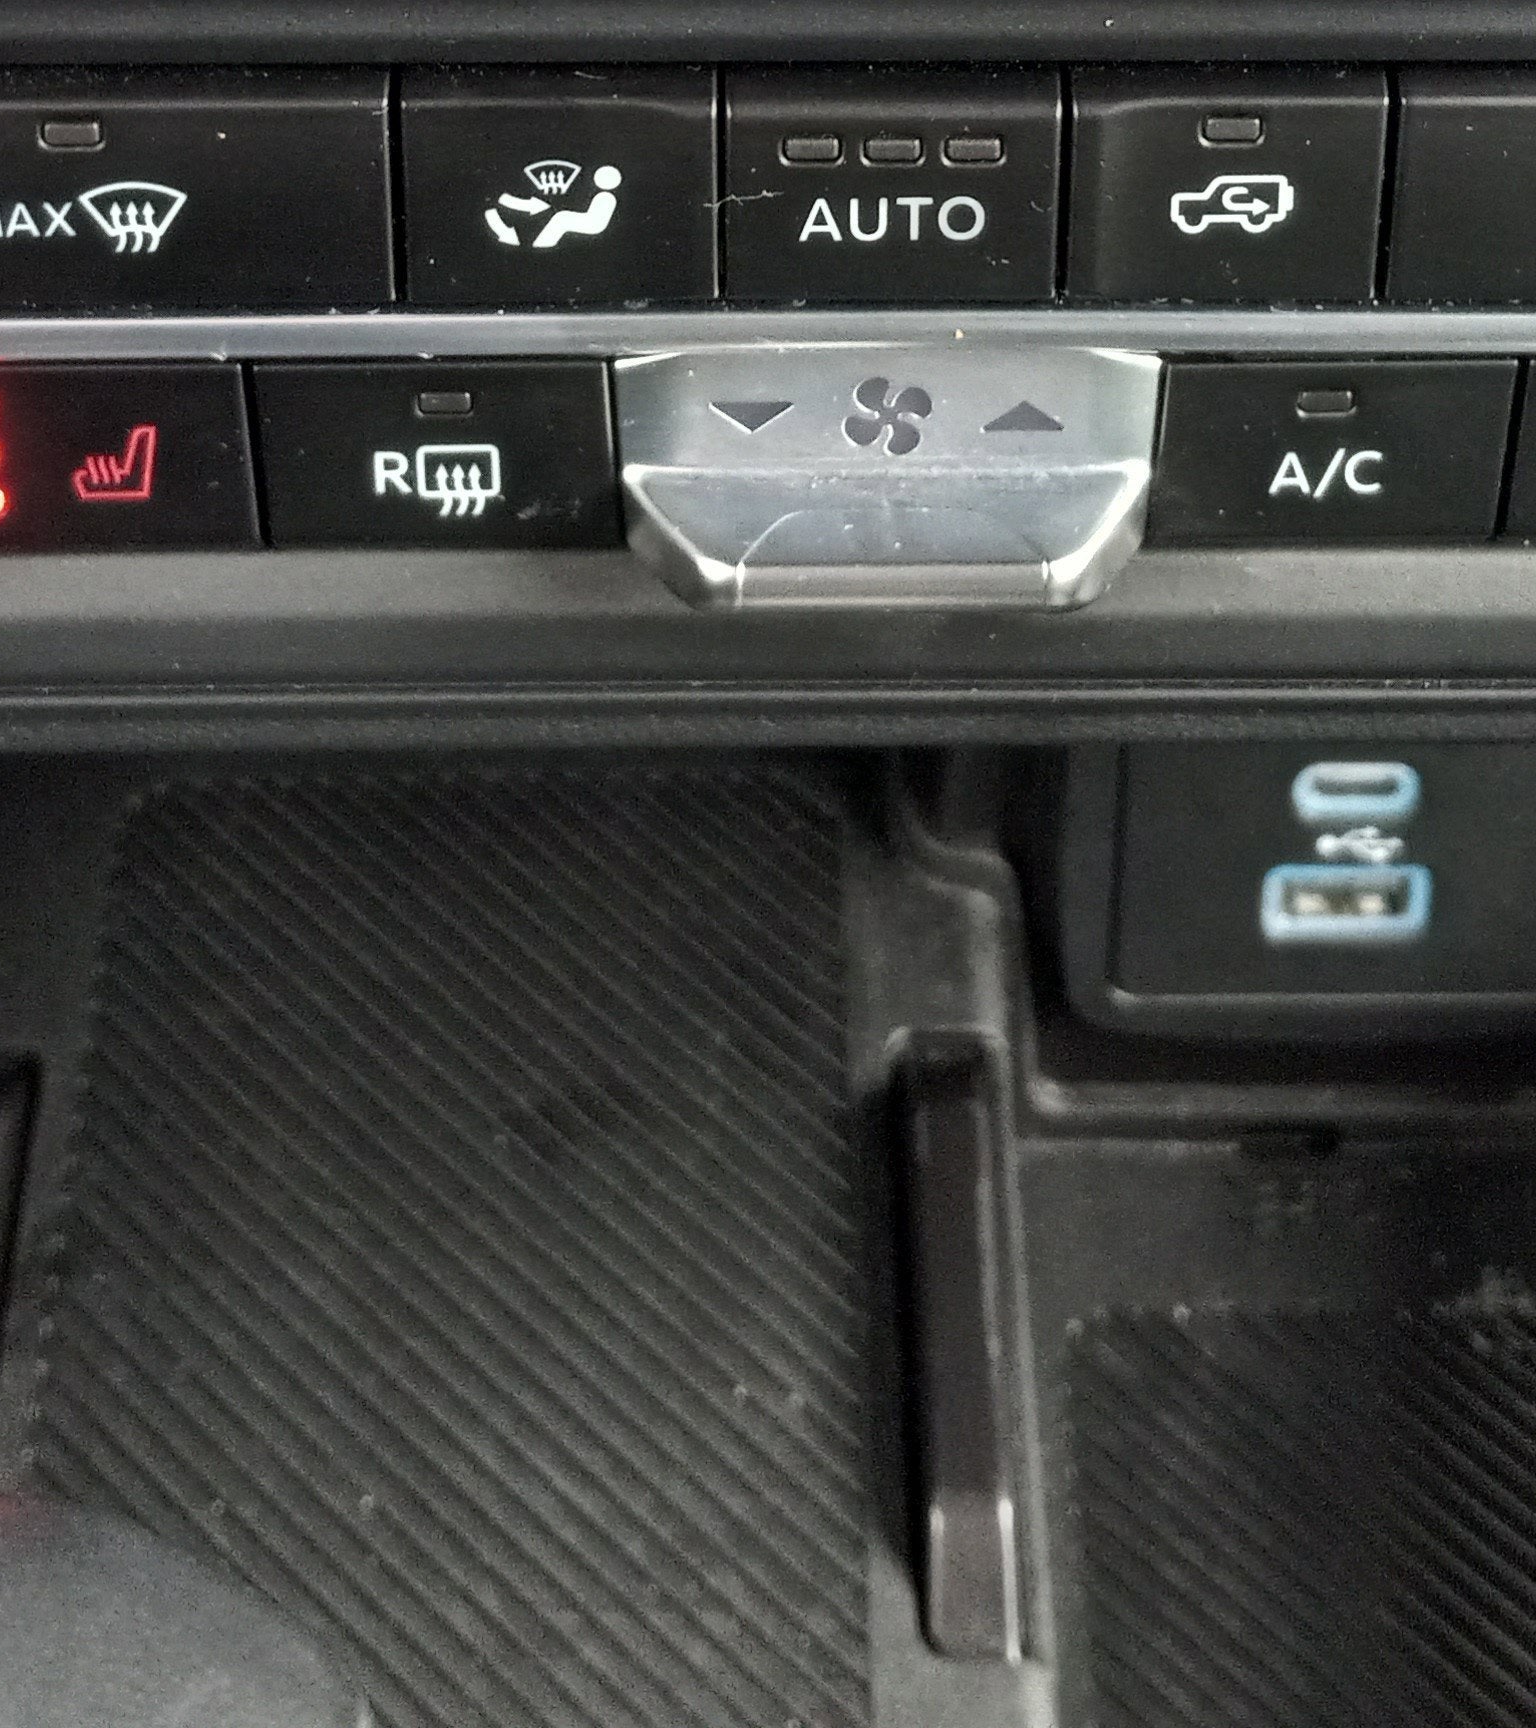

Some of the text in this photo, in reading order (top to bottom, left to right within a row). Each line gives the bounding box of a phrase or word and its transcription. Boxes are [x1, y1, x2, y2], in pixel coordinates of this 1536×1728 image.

[800, 196, 985, 242] AUTO
[373, 451, 410, 494] R
[1269, 448, 1382, 498] A/C
